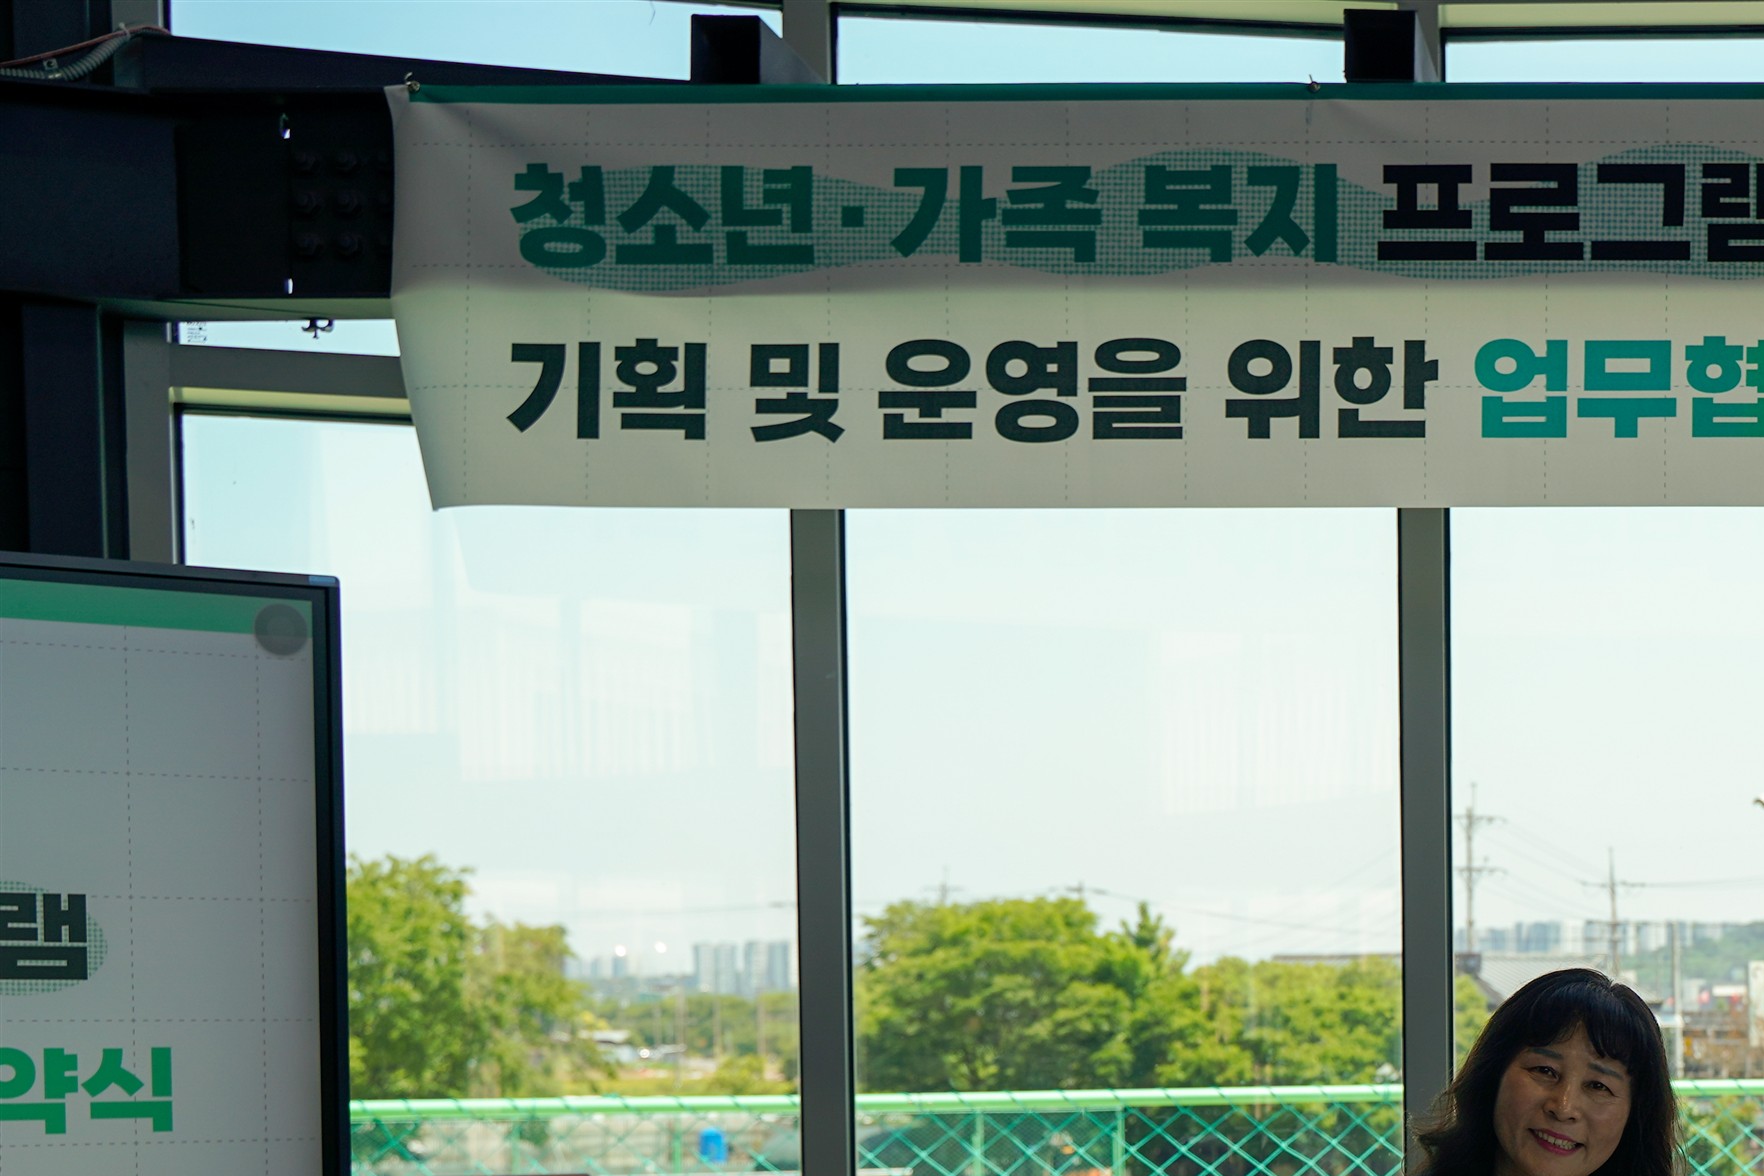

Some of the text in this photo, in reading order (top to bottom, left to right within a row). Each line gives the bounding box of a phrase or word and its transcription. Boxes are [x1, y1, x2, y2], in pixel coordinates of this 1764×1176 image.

[509, 162, 1104, 268] 청소년·가족
[1138, 163, 1338, 264] 복지
[506, 338, 708, 442] 기획
[749, 341, 846, 444] 및
[877, 337, 1188, 444] 운영을
[1225, 336, 1440, 440] 위한
